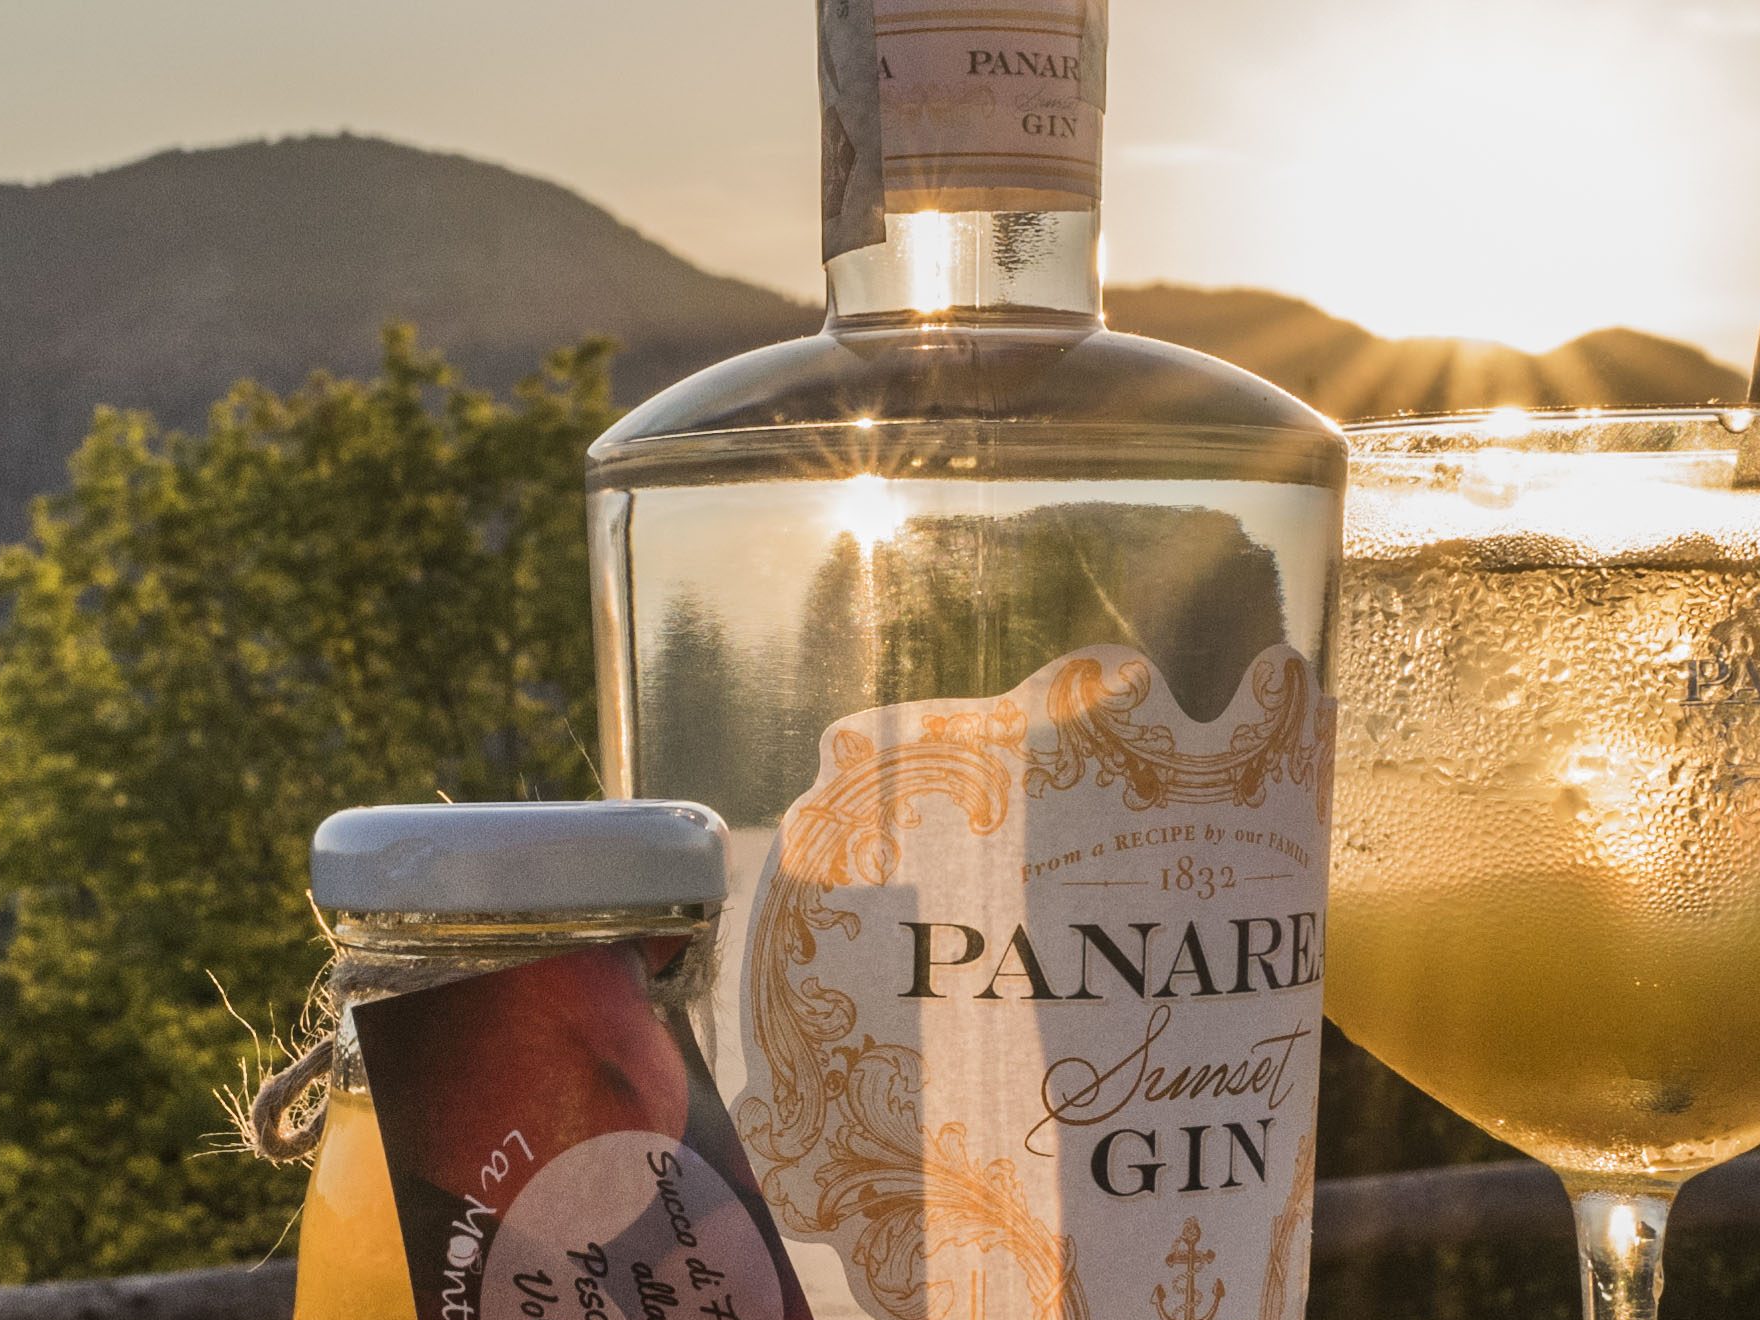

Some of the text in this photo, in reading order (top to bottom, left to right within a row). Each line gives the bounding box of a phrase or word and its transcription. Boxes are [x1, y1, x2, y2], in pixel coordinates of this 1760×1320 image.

[967, 50, 1080, 80] PANAR
[1021, 113, 1077, 138] GIN
[1021, 848, 1082, 884] From
[1092, 842, 1105, 857] a
[1113, 824, 1196, 851] RECIPE
[1203, 823, 1227, 846] by
[1234, 828, 1264, 845] our
[1160, 856, 1237, 900] 1832
[1024, 1004, 1311, 1157] Sunset
[480, 1128, 535, 1191] La
[1090, 1117, 1276, 1197] GIN
[646, 1150, 698, 1248] Succo
[685, 1257, 726, 1291] di
